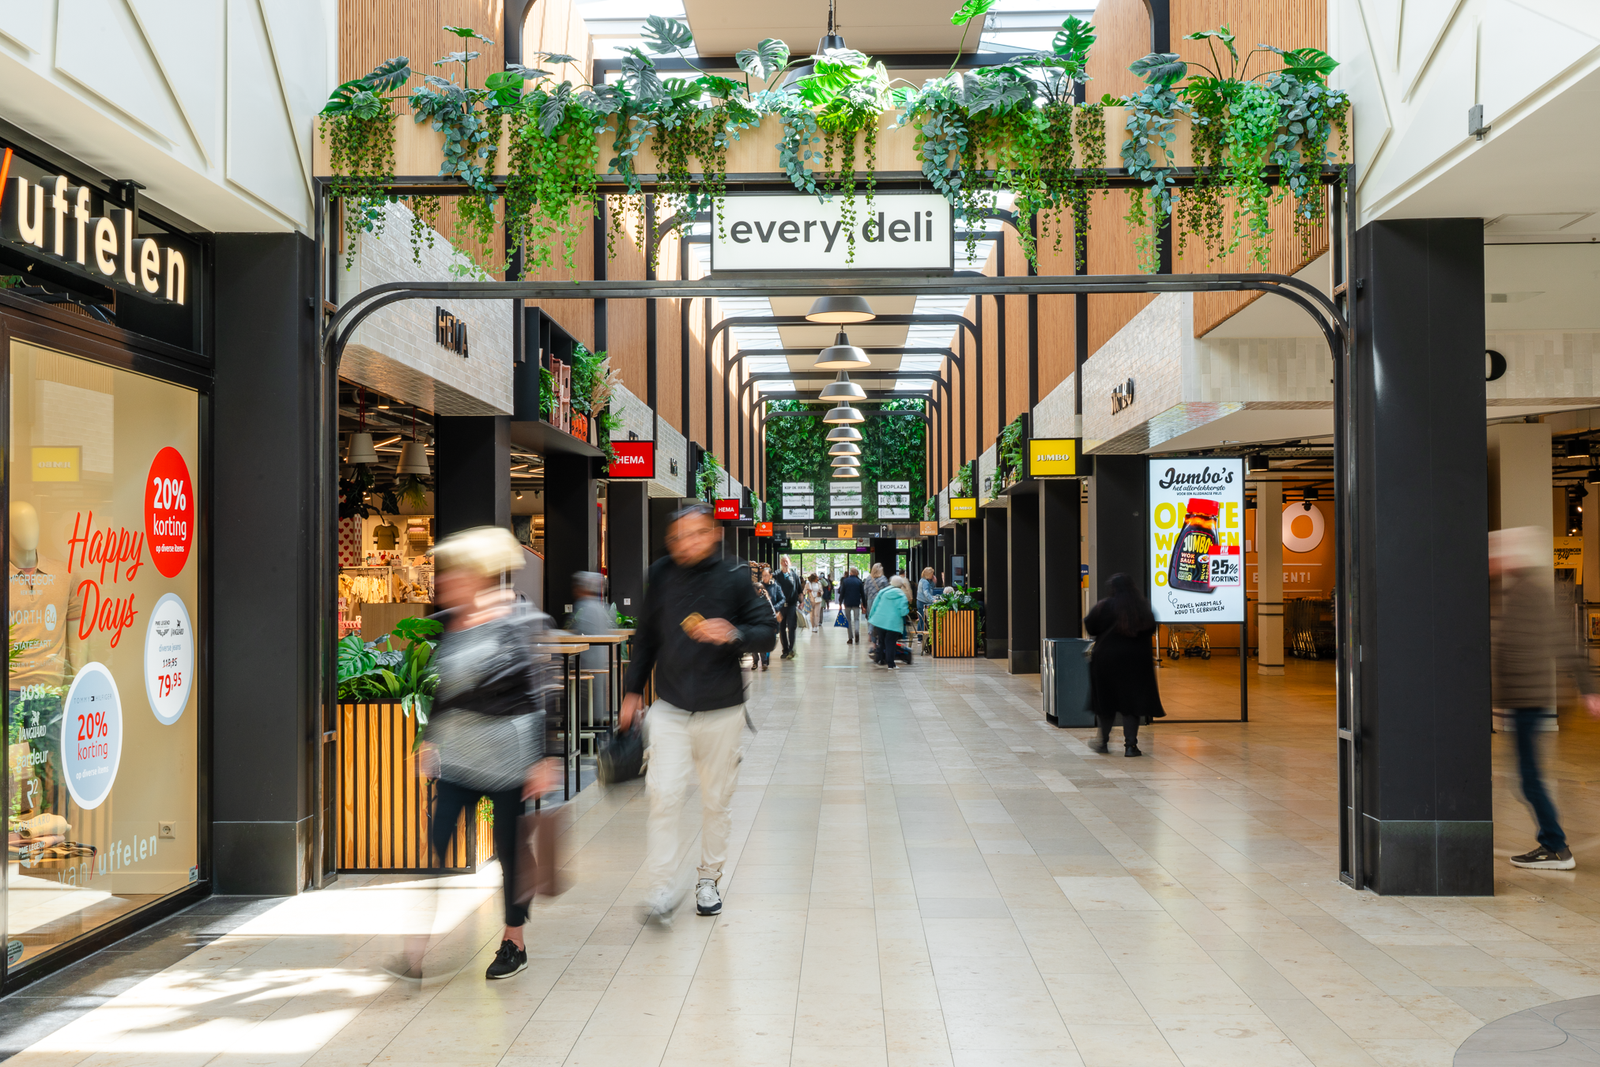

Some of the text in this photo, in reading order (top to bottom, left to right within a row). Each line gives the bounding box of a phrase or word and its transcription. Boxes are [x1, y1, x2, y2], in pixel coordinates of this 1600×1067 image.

[862, 211, 932, 243] deli
[617, 455, 645, 465] HEMA
[1036, 454, 1070, 462] JUMBO
[1159, 466, 1234, 489] Jumbo's
[153, 477, 187, 511] 20%
[153, 513, 187, 541] korting
[68, 510, 144, 585] Happy
[1212, 559, 1238, 574] 25%
[9, 610, 42, 625] NORTH
[77, 579, 138, 648] Days
[13, 641, 33, 651] STATE
[39, 639, 52, 648] ART
[20, 683, 45, 701] BOSS
[158, 672, 182, 698] 79,95
[77, 711, 108, 741] 20%
[16, 748, 49, 773] gardeur
[77, 740, 108, 761] korting
[82, 769, 97, 778] diverse
